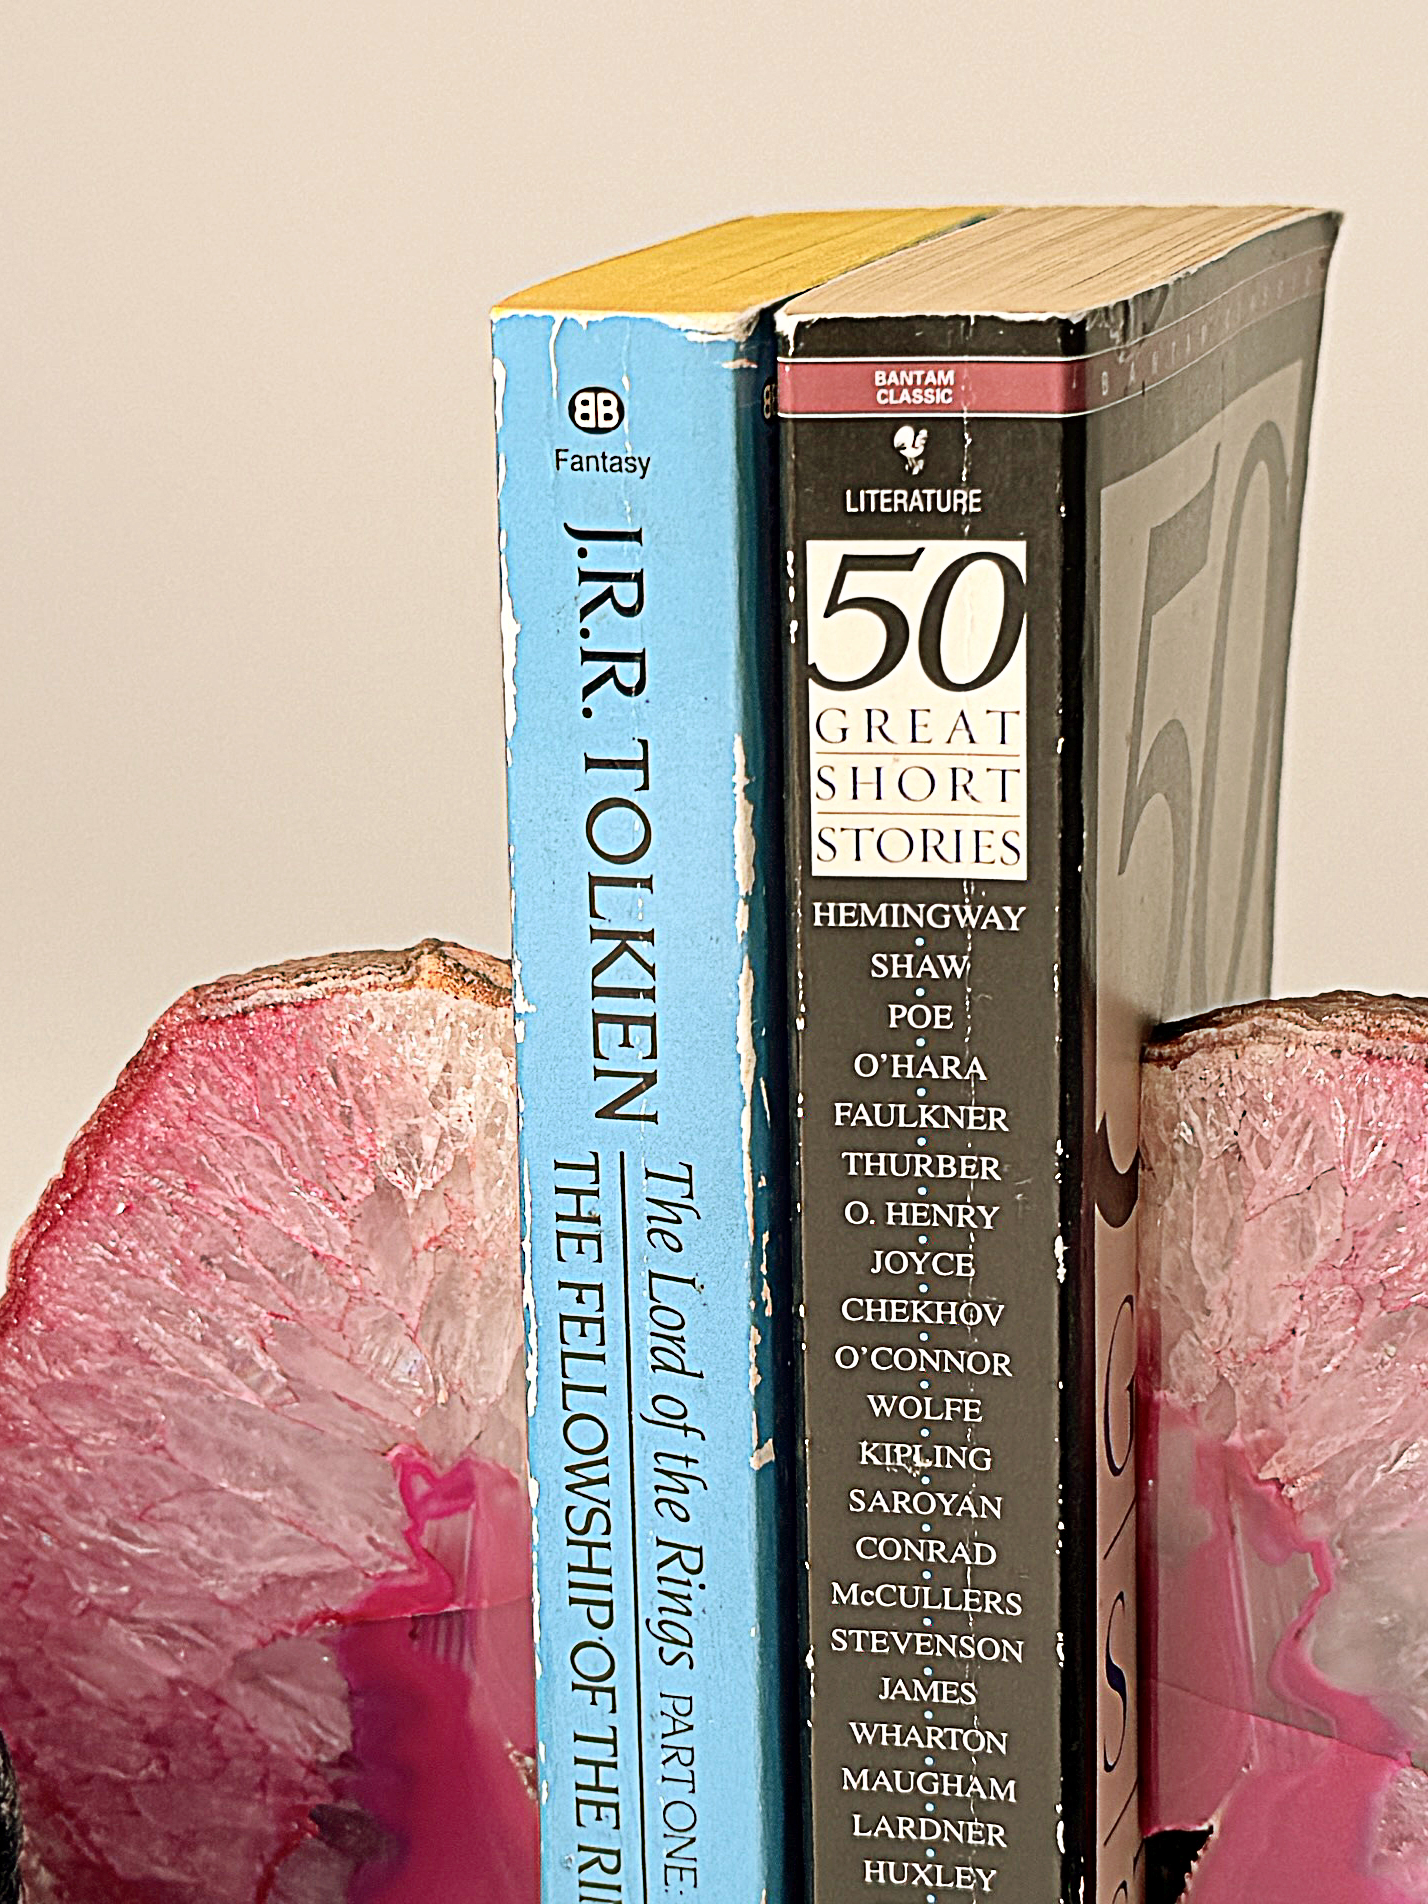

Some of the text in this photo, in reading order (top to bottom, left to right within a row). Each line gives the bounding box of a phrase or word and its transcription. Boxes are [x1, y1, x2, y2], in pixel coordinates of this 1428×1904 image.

[874, 369, 956, 387] BANTAM
[876, 388, 953, 405] CLASSIC
[554, 448, 651, 480] Fantasy
[845, 489, 982, 514] LITERATURE
[807, 546, 1026, 693] 50
[814, 707, 1022, 747] GREAT
[814, 765, 1022, 804] SHORT
[563, 521, 659, 1126] J.R.R. TOLKIEN
[815, 825, 1023, 867] STORIES
[813, 902, 1027, 932] HEMINGWAY
[870, 953, 970, 980] SHAW
[888, 1004, 954, 1031] POE
[854, 1052, 988, 1082] O'HARA
[833, 1102, 1010, 1133] FAULKNER
[841, 1151, 1002, 1181] THURBER
[553, 1150, 604, 1264] THE
[843, 1199, 1000, 1230] O. HENRY
[870, 1250, 976, 1278] JOYCE
[840, 1297, 1005, 1328] CHEKHOV
[834, 1345, 1013, 1378] O'CONNOR
[867, 1394, 984, 1423] WOLFE
[557, 1280, 616, 1629] FELLOWSHIP
[859, 1440, 993, 1472] KIPLING
[848, 1488, 1003, 1520] SAROYAN
[639, 1161, 708, 1896] The Lord of the Rings PART ONE:
[855, 1536, 997, 1567] CONRAD
[831, 1582, 1023, 1617] McCULLERS
[830, 1629, 1025, 1664] STEVENSON
[569, 1639, 619, 1716] OF
[878, 1677, 977, 1706] JAMES
[848, 1721, 1008, 1755] WHARTON
[573, 1726, 622, 1829] THE
[841, 1767, 1017, 1803] MAUGHAM
[852, 1813, 1008, 1848] LARDNER
[863, 1859, 998, 1893] HUXLEY
